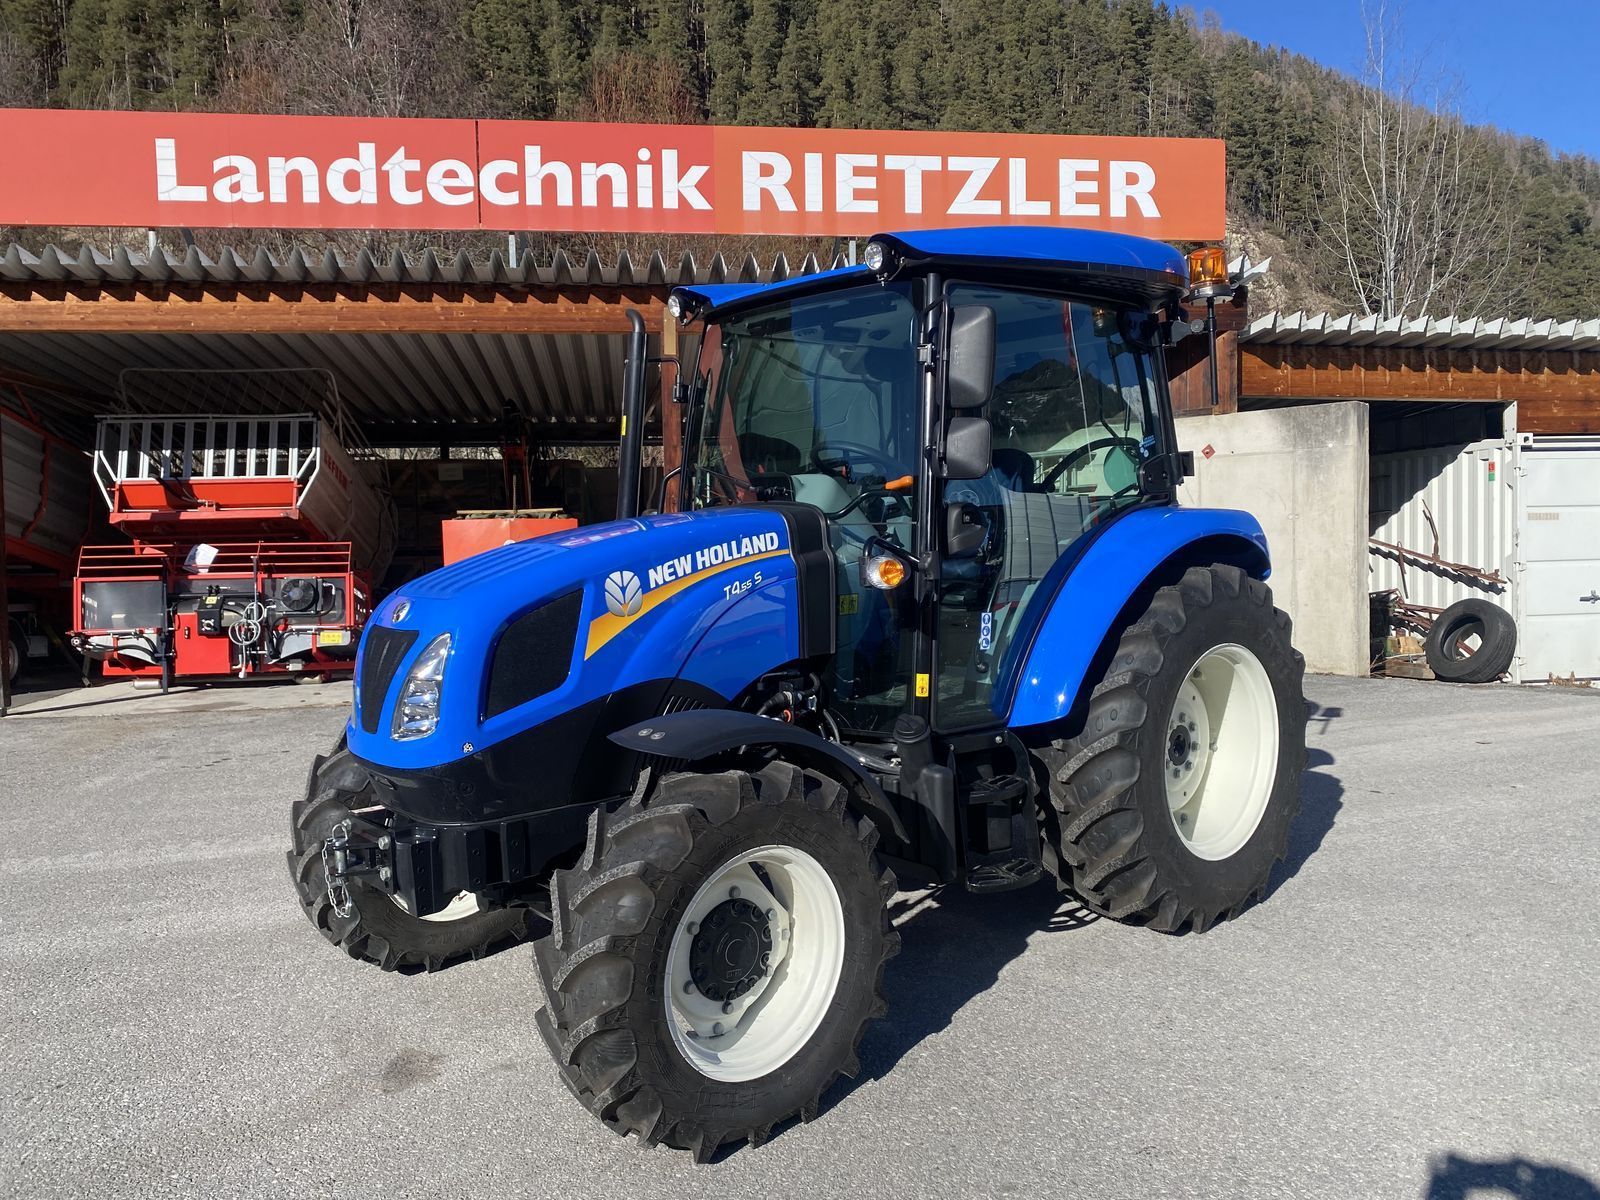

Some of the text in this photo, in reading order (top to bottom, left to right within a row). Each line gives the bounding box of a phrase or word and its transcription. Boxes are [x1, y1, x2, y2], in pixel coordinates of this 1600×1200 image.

[154, 137, 1161, 220] Landtechnik RIETZLER
[648, 532, 779, 589] NEW HOLLAND
[754, 571, 763, 585] S
